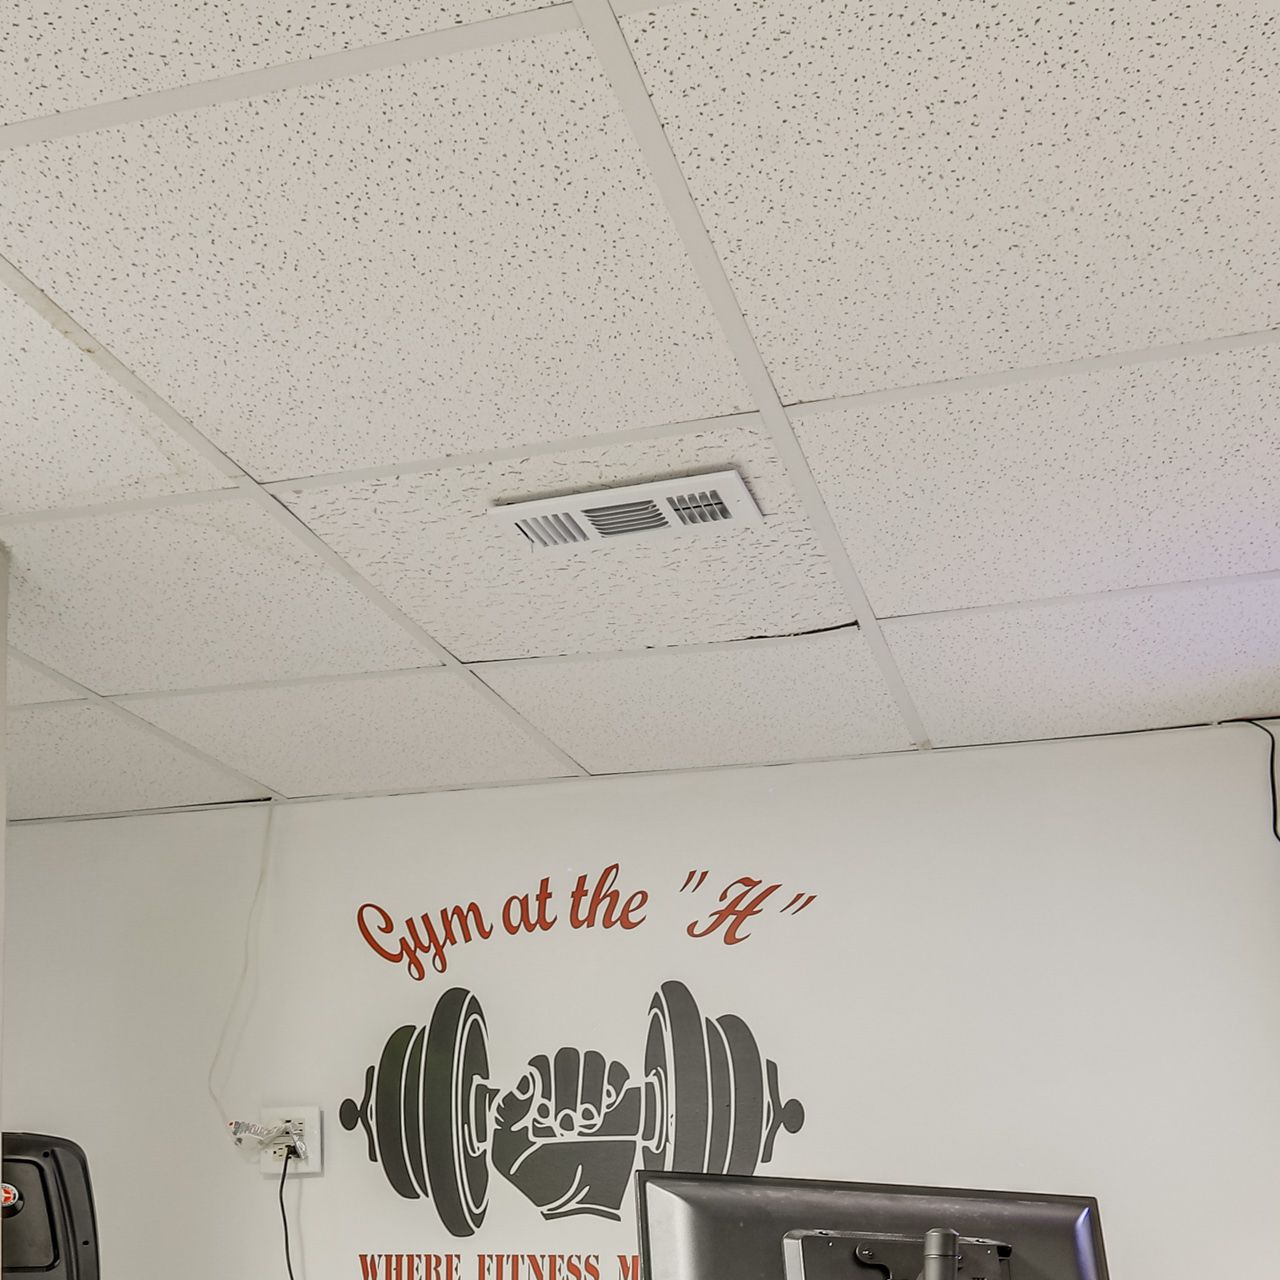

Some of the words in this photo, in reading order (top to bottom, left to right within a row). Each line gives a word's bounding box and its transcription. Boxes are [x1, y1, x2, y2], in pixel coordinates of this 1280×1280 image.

[357, 897, 494, 981] Gym
[502, 877, 558, 936] at
[569, 863, 649, 931] the
